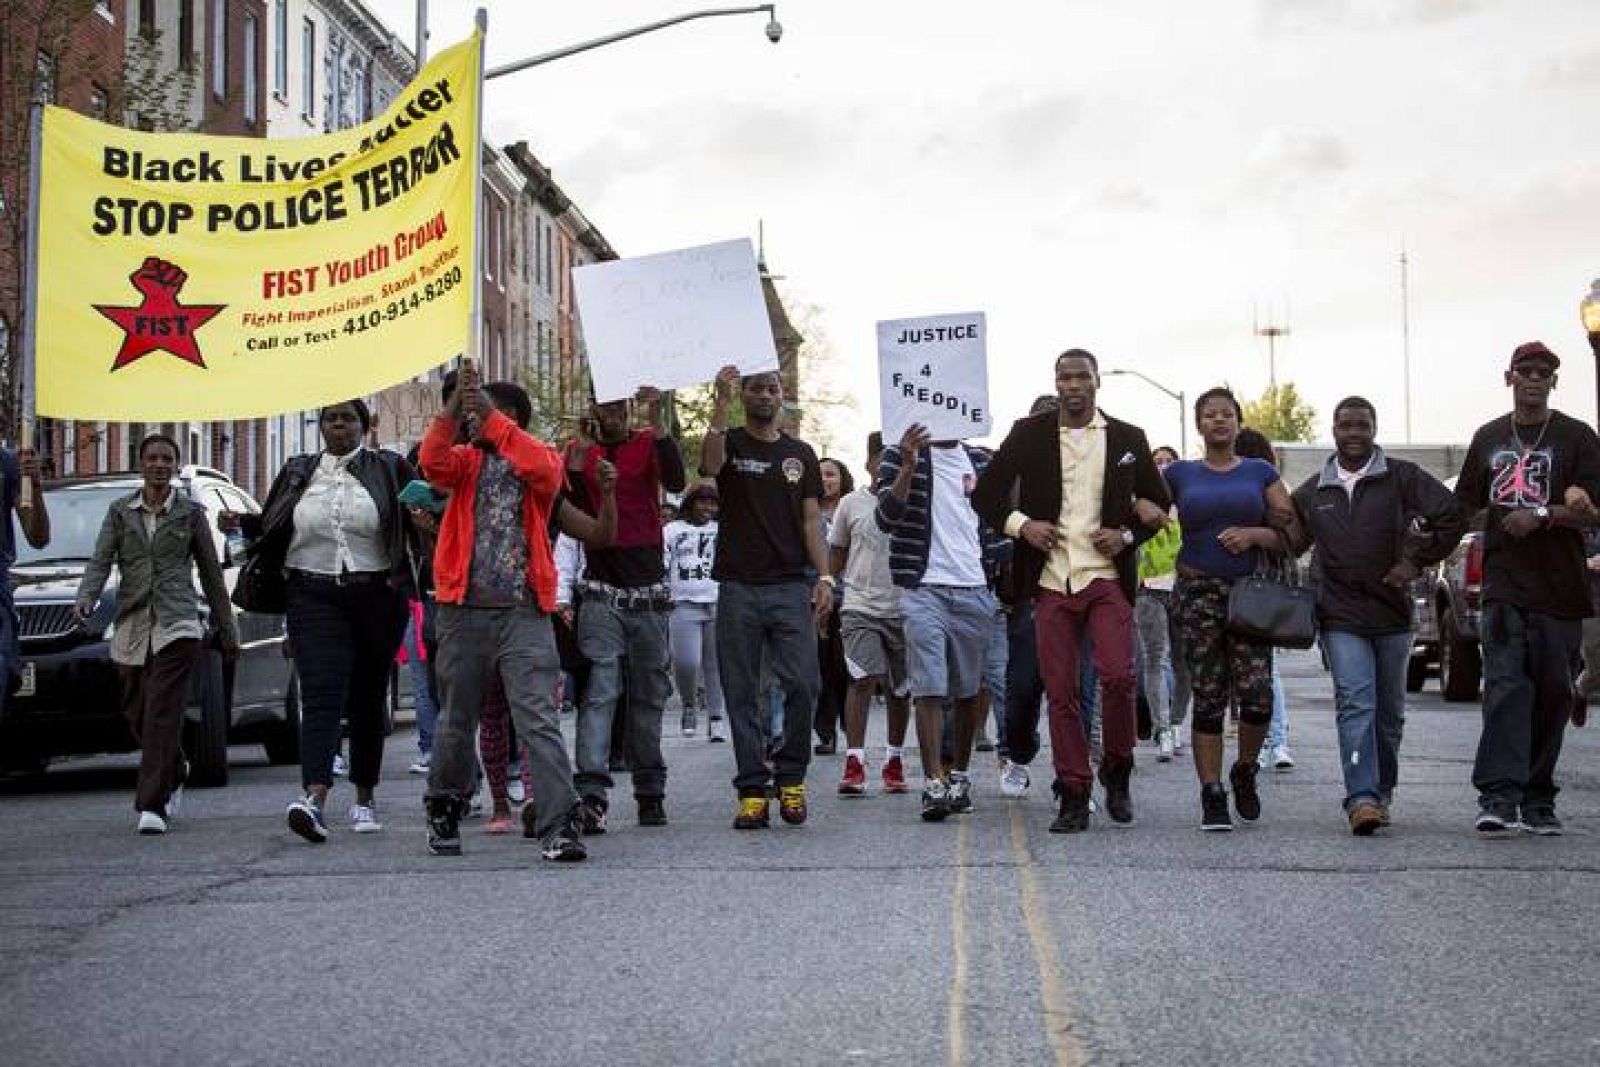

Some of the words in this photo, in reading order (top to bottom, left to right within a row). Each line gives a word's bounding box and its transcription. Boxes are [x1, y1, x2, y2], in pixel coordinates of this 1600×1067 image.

[103, 146, 225, 183] Black
[358, 78, 453, 153] atter
[92, 196, 194, 236] STOP
[207, 180, 347, 233] POLICE
[352, 121, 461, 211] TERROR
[263, 267, 320, 299] FIST
[327, 244, 390, 288] Youth
[395, 209, 448, 261] Group
[135, 314, 190, 337] FIST
[242, 312, 283, 328] Fight
[381, 271, 417, 298] Stand
[246, 337, 279, 352] Call
[284, 337, 305, 348] or
[304, 329, 337, 345] Text
[342, 266, 462, 336] 410-914-8280
[897, 323, 978, 344] JUSTICE
[892, 372, 983, 423] FREDDIE
[920, 363, 932, 377] 4
[1489, 450, 1552, 506] 23
